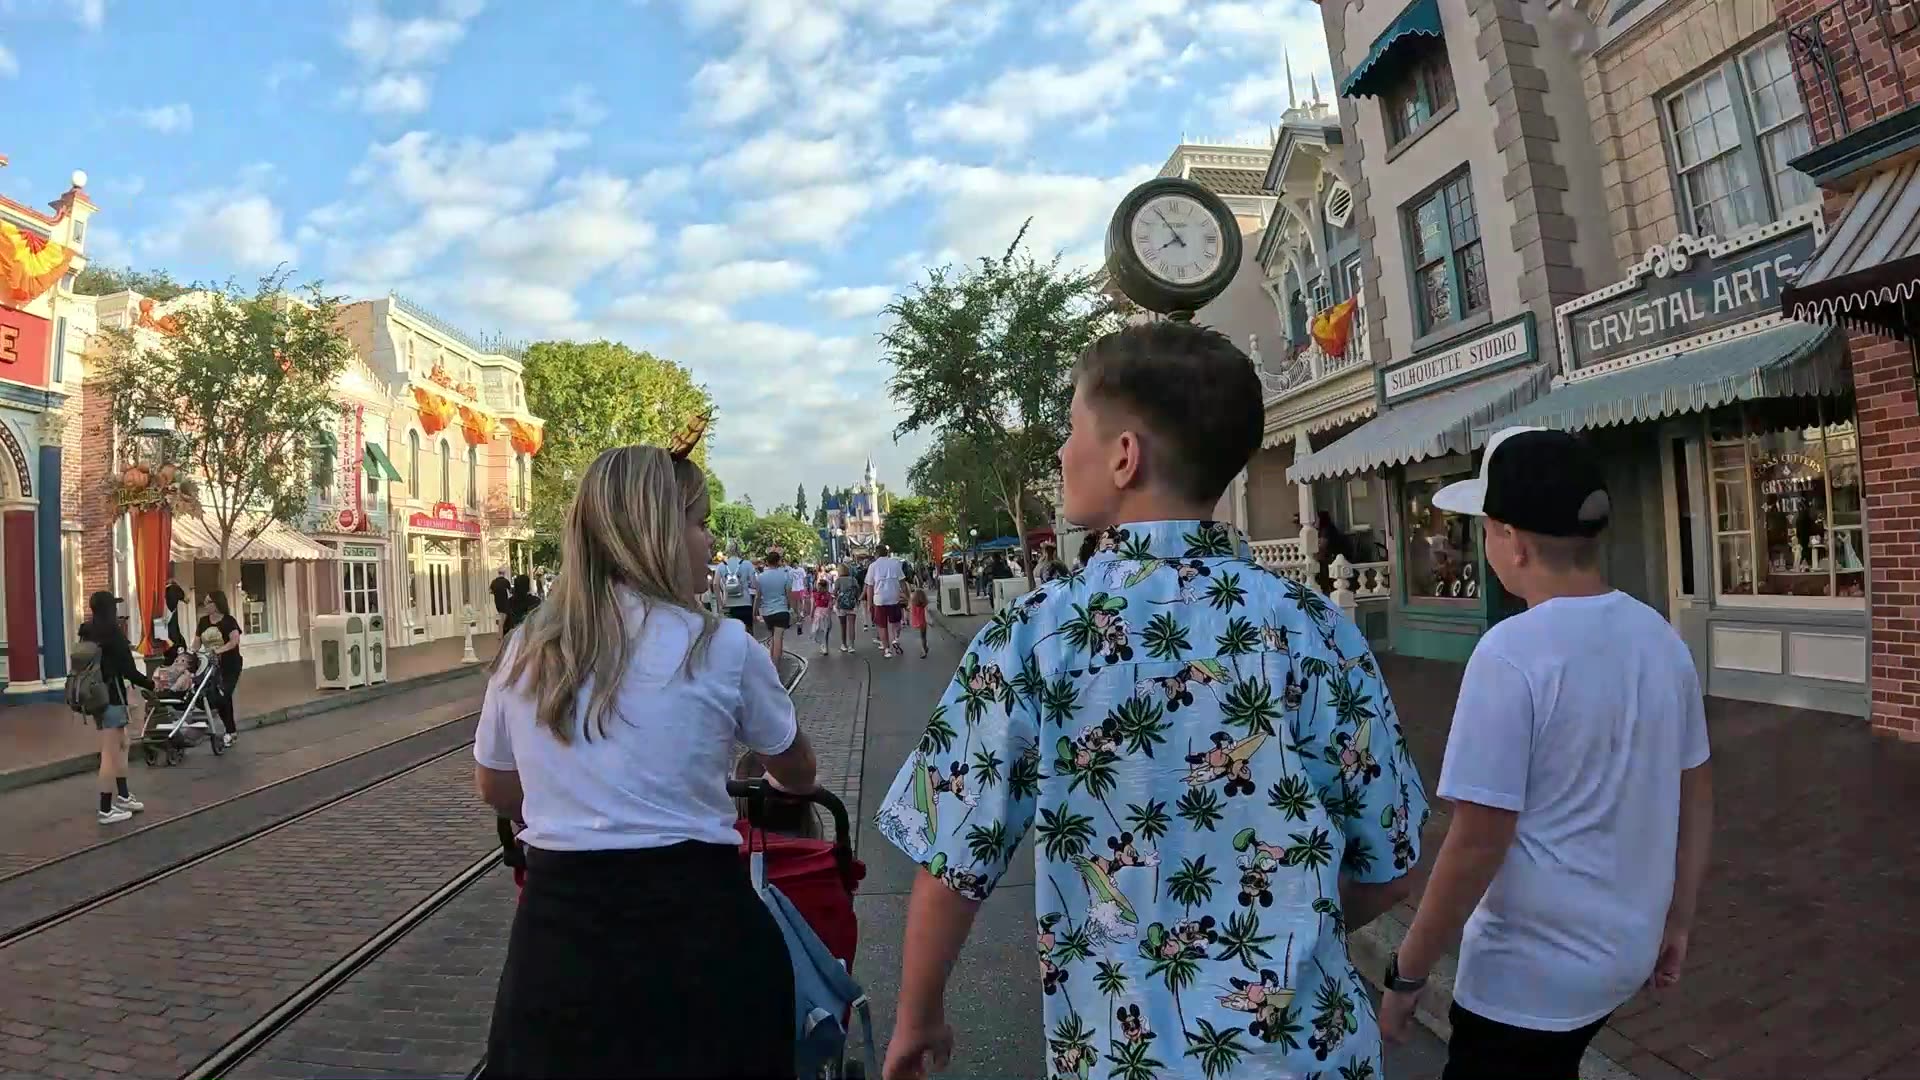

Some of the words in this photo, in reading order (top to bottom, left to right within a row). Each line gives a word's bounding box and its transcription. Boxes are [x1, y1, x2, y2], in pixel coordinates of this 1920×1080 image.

[1588, 287, 1705, 350] CRYSTAL
[1712, 253, 1796, 314] ARTS
[1391, 351, 1463, 391] SILHOUETTE
[1469, 331, 1517, 364] STUDIO
[1781, 454, 1821, 473] CUTTERS
[1761, 475, 1814, 495] CRYSTAL
[1776, 497, 1807, 513] ARTS
